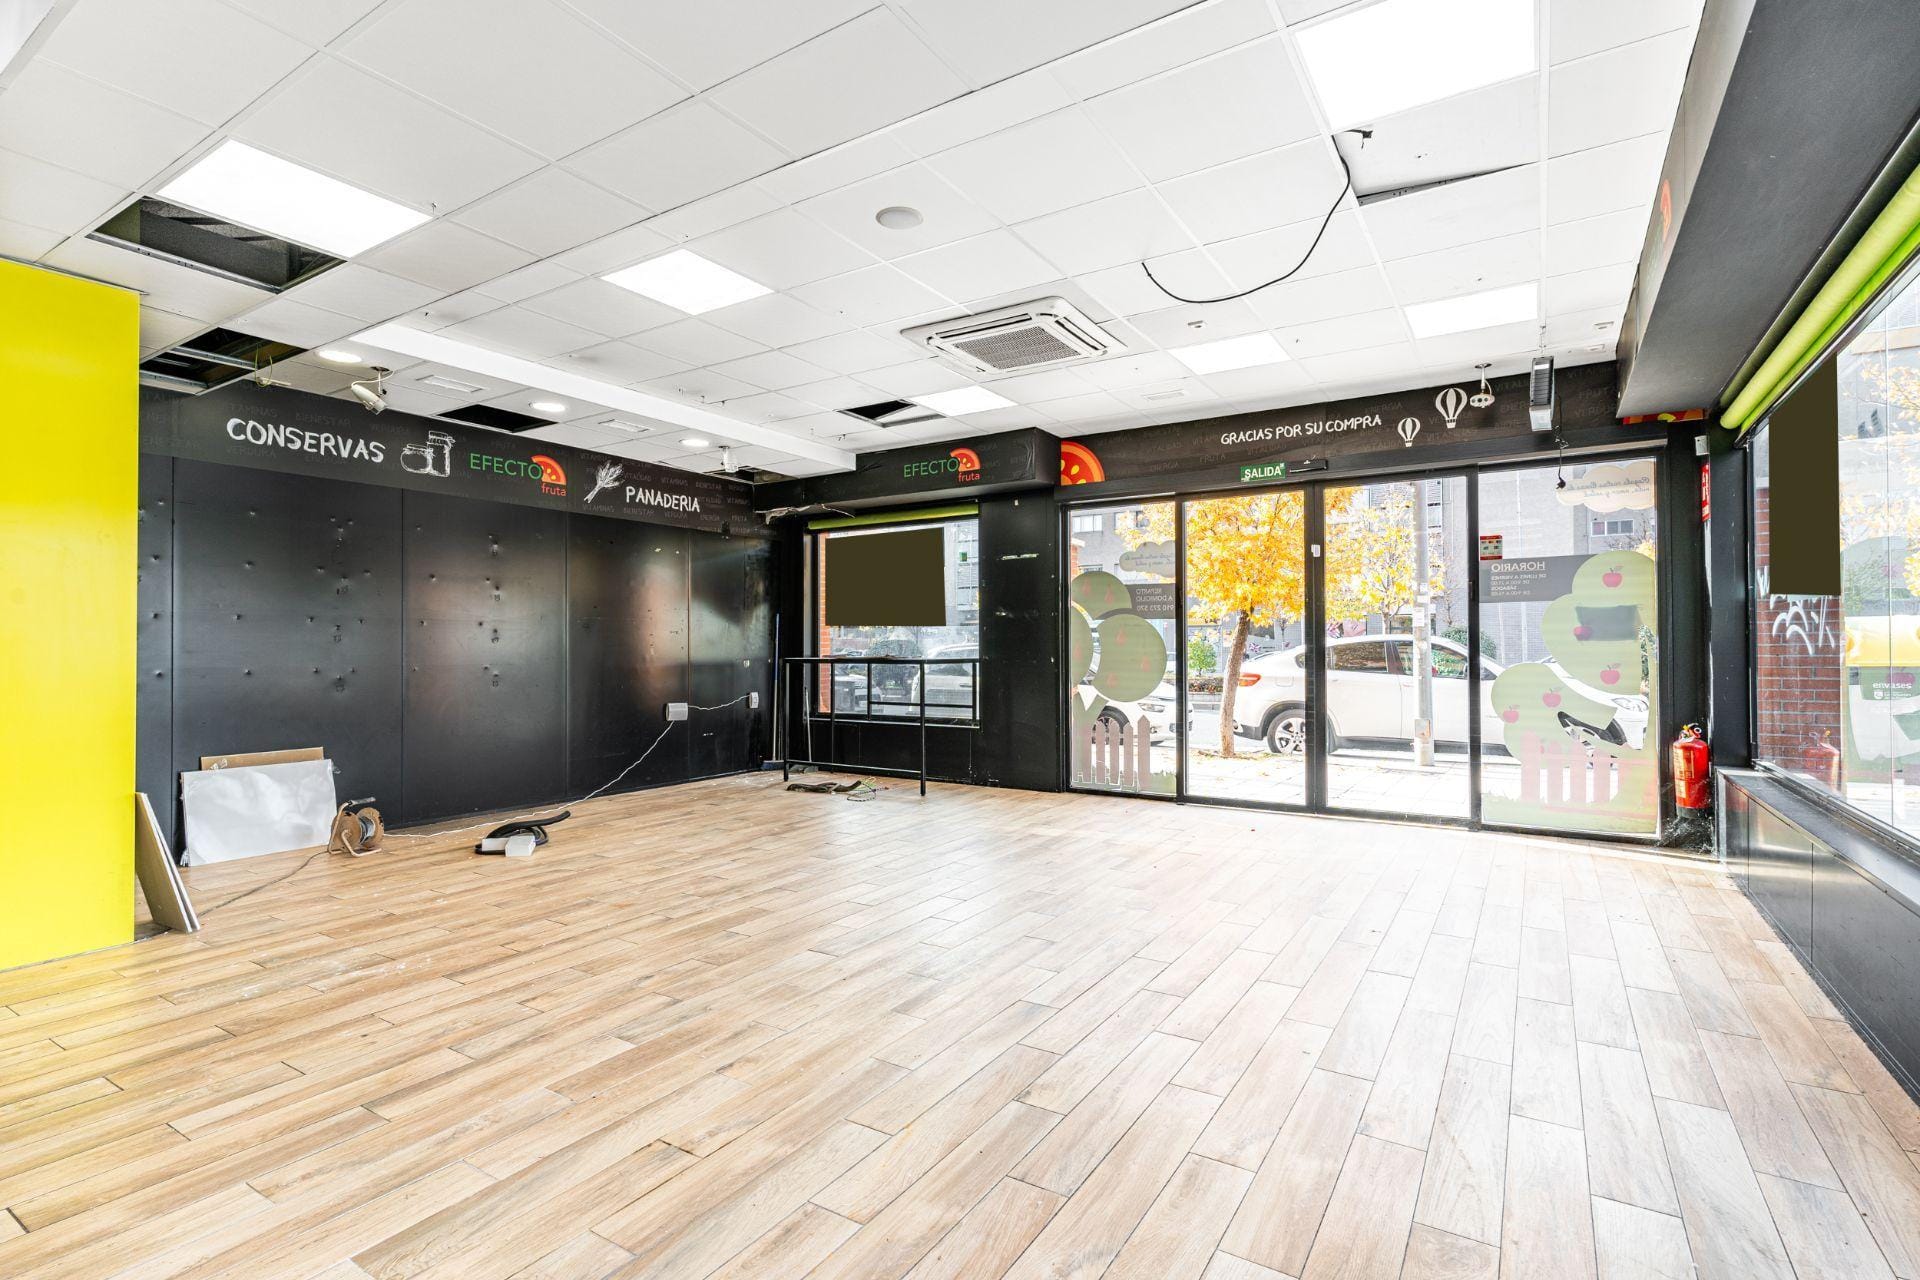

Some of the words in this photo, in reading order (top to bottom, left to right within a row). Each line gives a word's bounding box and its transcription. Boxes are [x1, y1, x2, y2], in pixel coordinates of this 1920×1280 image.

[226, 417, 387, 463] CONSERVAS
[1220, 427, 1273, 446] GRACIAS
[1275, 424, 1303, 439] POR
[1304, 420, 1323, 435] SU
[1325, 413, 1383, 433] COMPRA
[469, 452, 543, 480] EFECTO
[541, 483, 568, 497] fruta
[903, 457, 959, 478] EFECTO
[958, 472, 982, 483] fruta
[1244, 466, 1282, 479] SALIDA
[625, 485, 701, 513] PANADERIA
